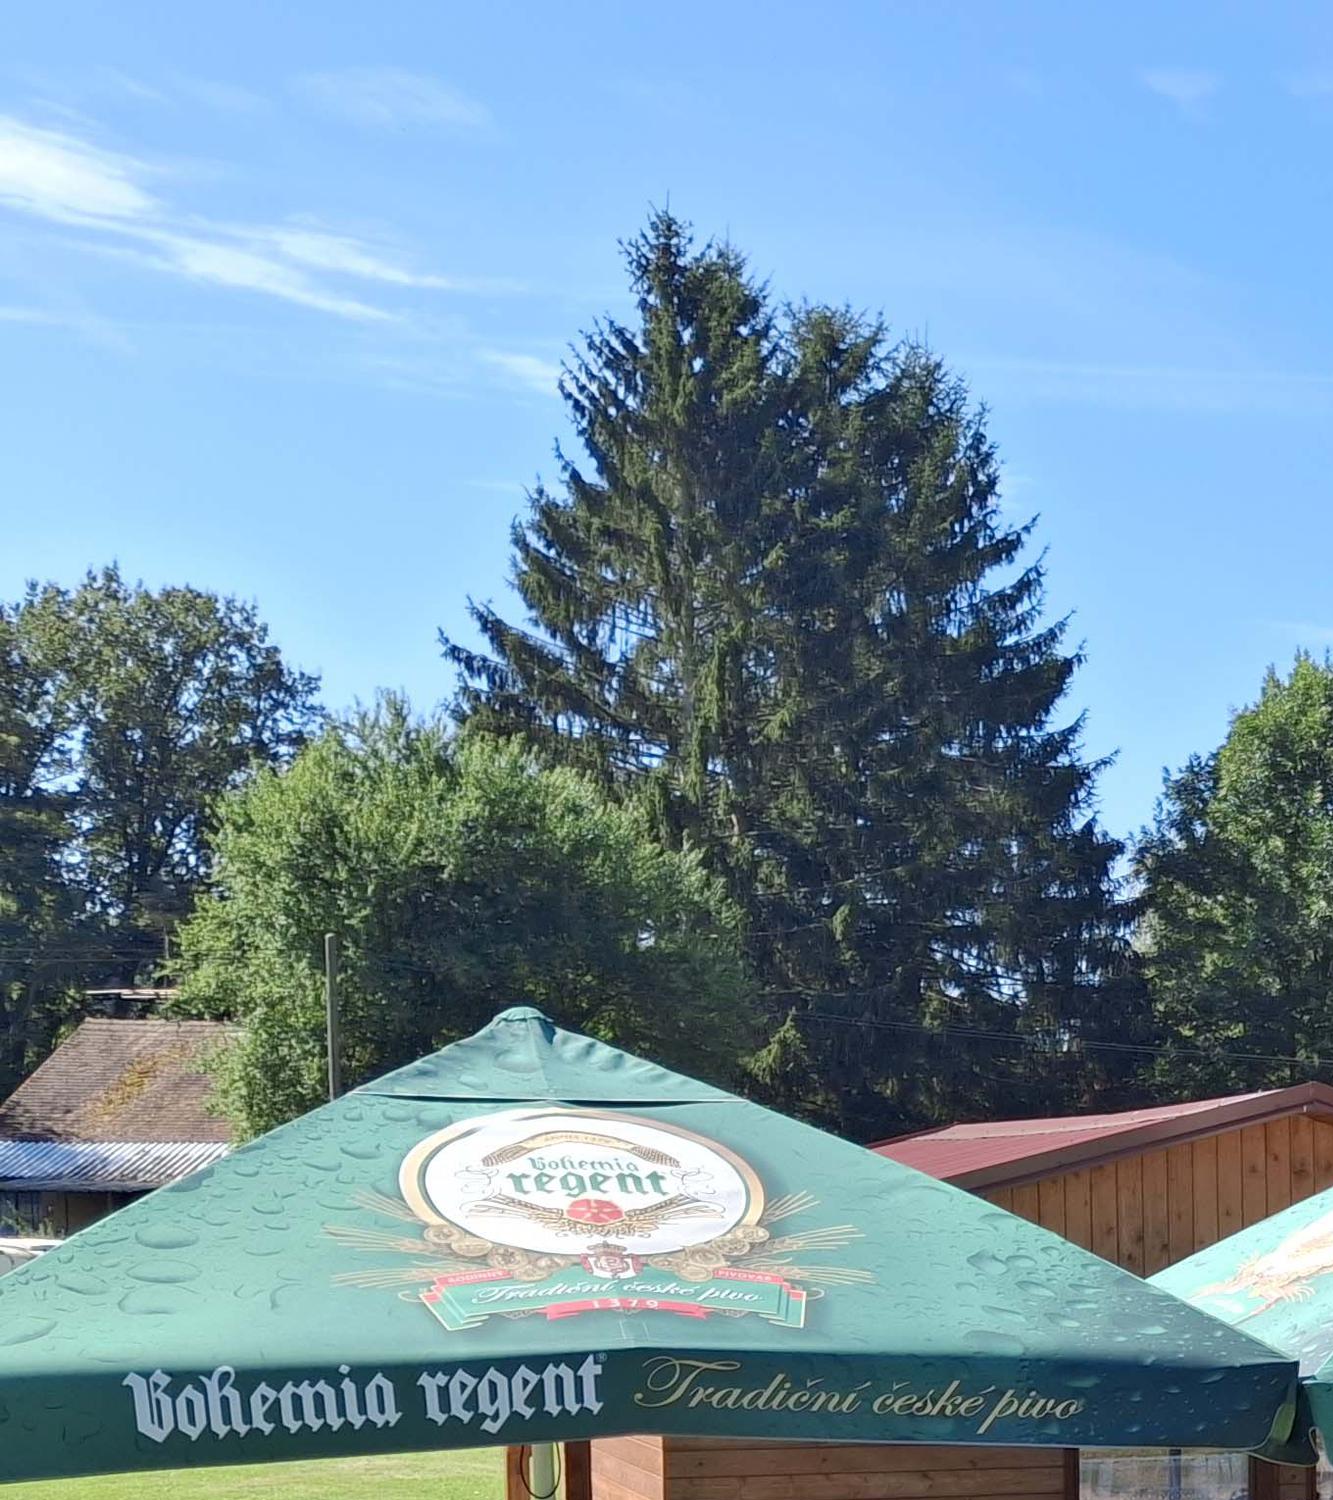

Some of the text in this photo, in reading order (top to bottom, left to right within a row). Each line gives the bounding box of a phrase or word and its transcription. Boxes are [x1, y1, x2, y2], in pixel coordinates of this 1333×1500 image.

[528, 1155, 639, 1172] Bohemia
[506, 1170, 670, 1198] regent
[717, 1269, 773, 1282] PIVOVAR
[697, 1285, 763, 1302] pivo
[592, 1298, 658, 1310] 1379
[122, 1352, 605, 1444] Bohemia regent
[634, 1354, 1083, 1436] Tradiční české pivo
